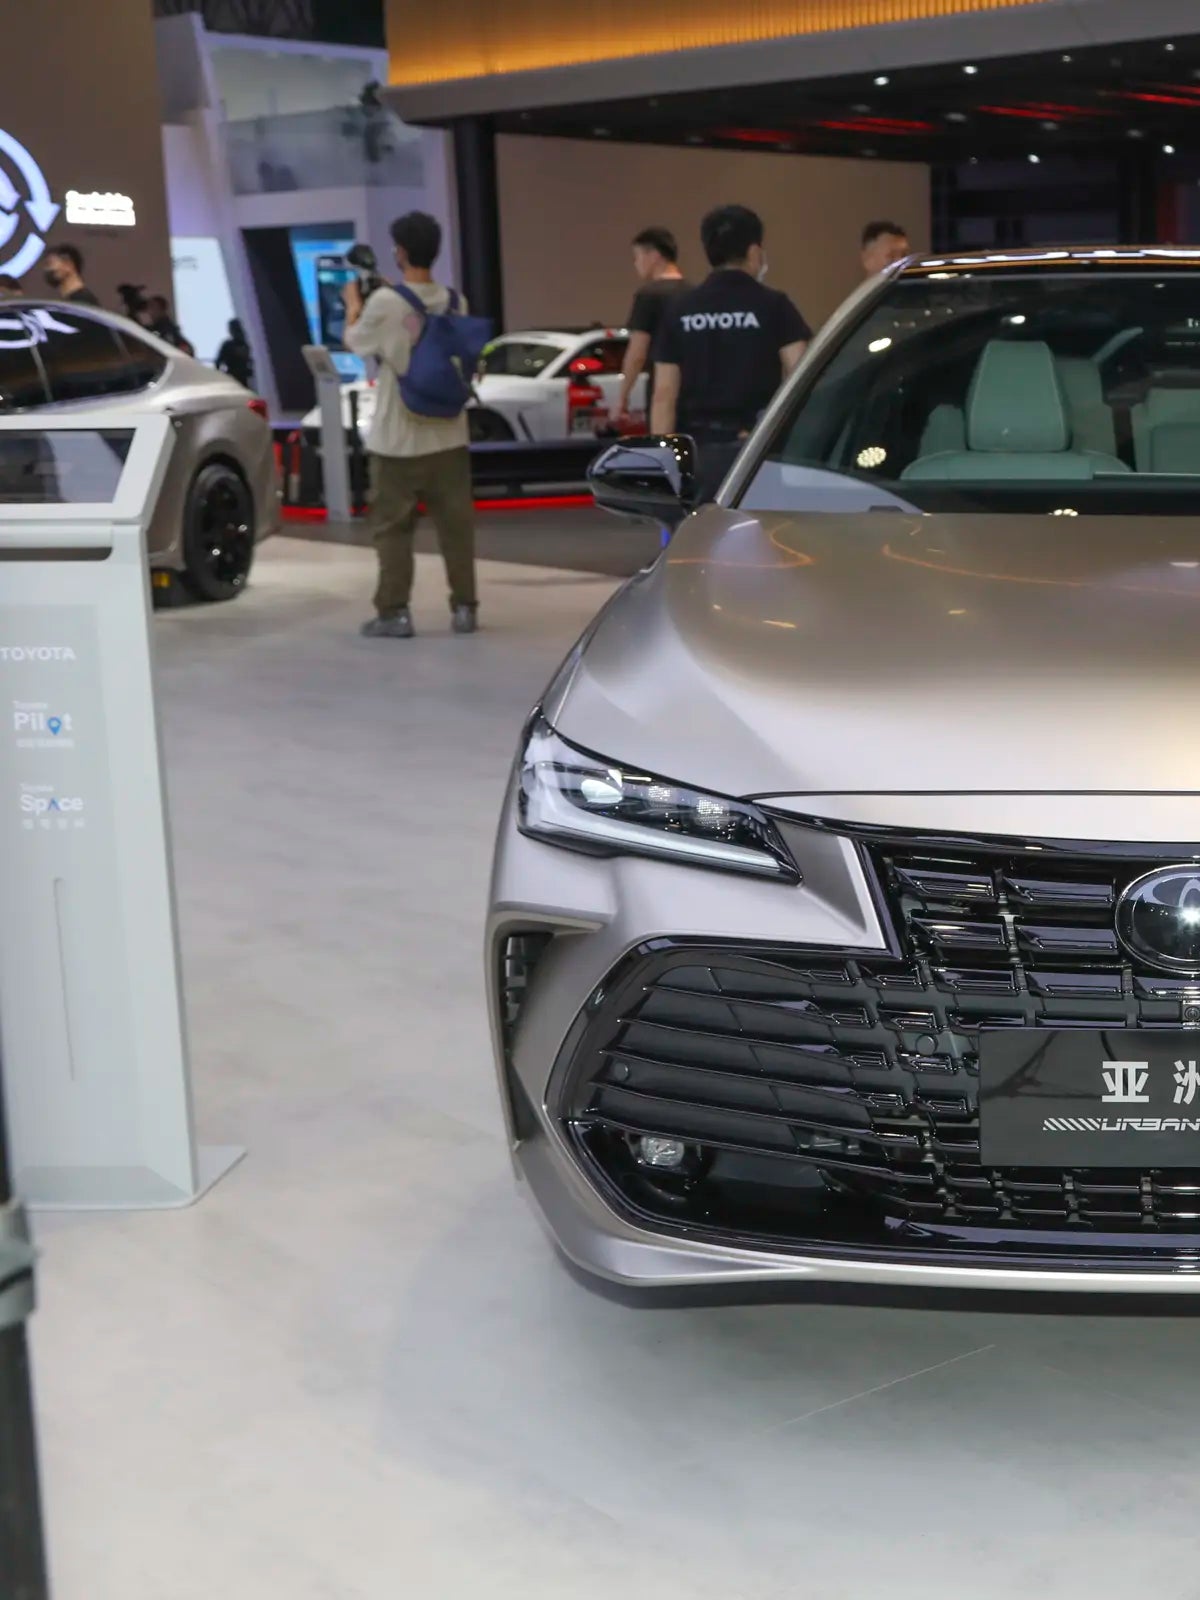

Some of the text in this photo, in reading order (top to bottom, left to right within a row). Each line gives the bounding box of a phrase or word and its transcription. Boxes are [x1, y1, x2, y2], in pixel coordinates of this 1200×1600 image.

[680, 311, 761, 333] TOYOTA
[0, 646, 76, 661] TOYOTA
[1100, 1117, 1200, 1132] URBAN
